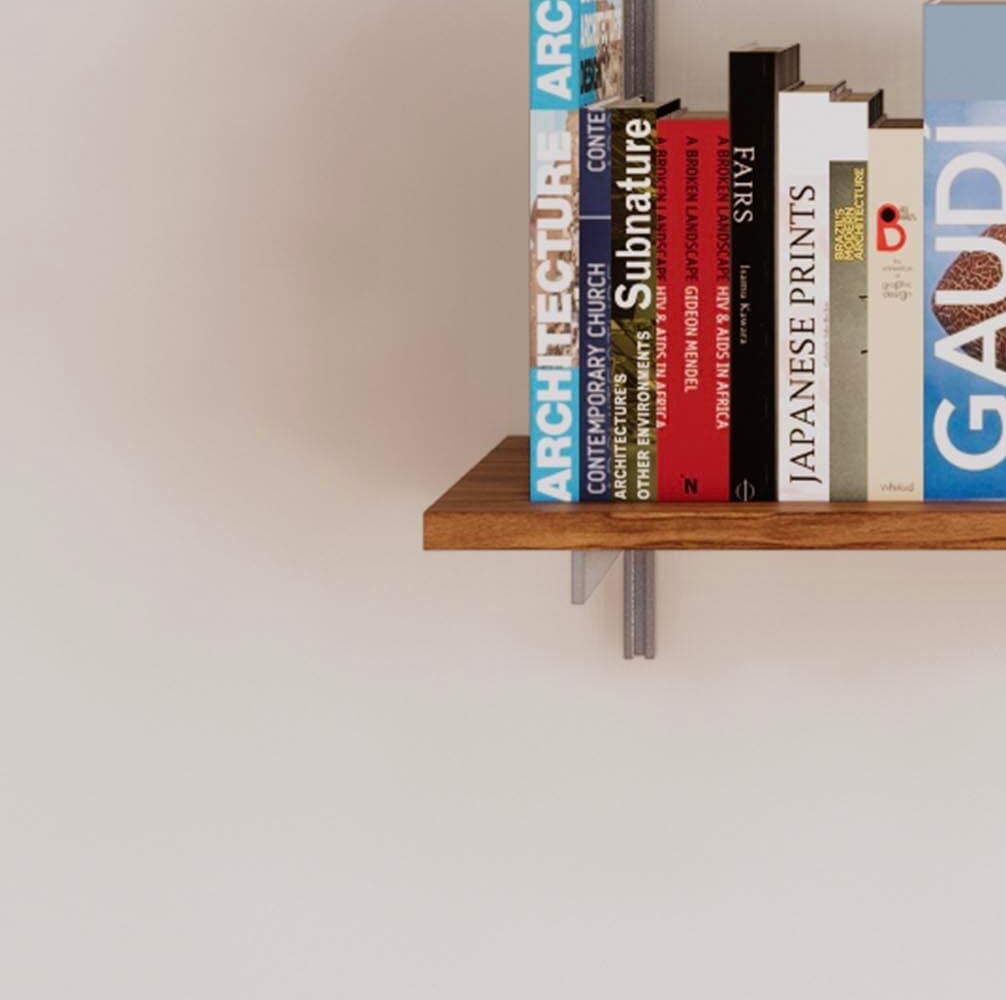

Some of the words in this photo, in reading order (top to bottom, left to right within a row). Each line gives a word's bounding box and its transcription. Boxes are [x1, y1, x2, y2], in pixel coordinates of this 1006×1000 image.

[656, 136, 667, 145] A
[685, 136, 699, 145] A
[716, 136, 730, 145] A
[656, 149, 667, 202] BROKEN
[685, 149, 699, 202] BROKEN
[716, 149, 730, 202] BROKEN
[733, 147, 755, 224] FAIRS
[614, 117, 652, 310] Subnature
[844, 206, 855, 260] MODERN
[854, 167, 865, 261] ARCHITECTURE
[656, 205, 667, 281] LANDSCAPE
[685, 205, 699, 281] LANDSCAPE
[716, 205, 730, 281] LANDSCAPE
[789, 185, 816, 307] PRINTS
[536, 131, 573, 502] ARCHITECTURE
[586, 263, 606, 338] CHURCH
[656, 286, 667, 310] HIV
[656, 313, 667, 323] &
[684, 285, 699, 337] GIDEON
[716, 286, 730, 310] HIV
[716, 313, 730, 323] &
[656, 328, 667, 360] AIDS
[656, 363, 667, 378] IN
[684, 340, 699, 393] MENDEL
[716, 328, 730, 360] AIDS
[716, 363, 730, 378] IN
[637, 330, 650, 446] ENVIRONMENTS
[656, 381, 667, 430] AFRICA
[716, 381, 730, 430] AFRICA
[789, 318, 823, 485] JAPANESE
[586, 345, 606, 495] CONTEMPORARY
[614, 373, 627, 500] ARCHITECTURE'S
[637, 451, 650, 500] OTHER
